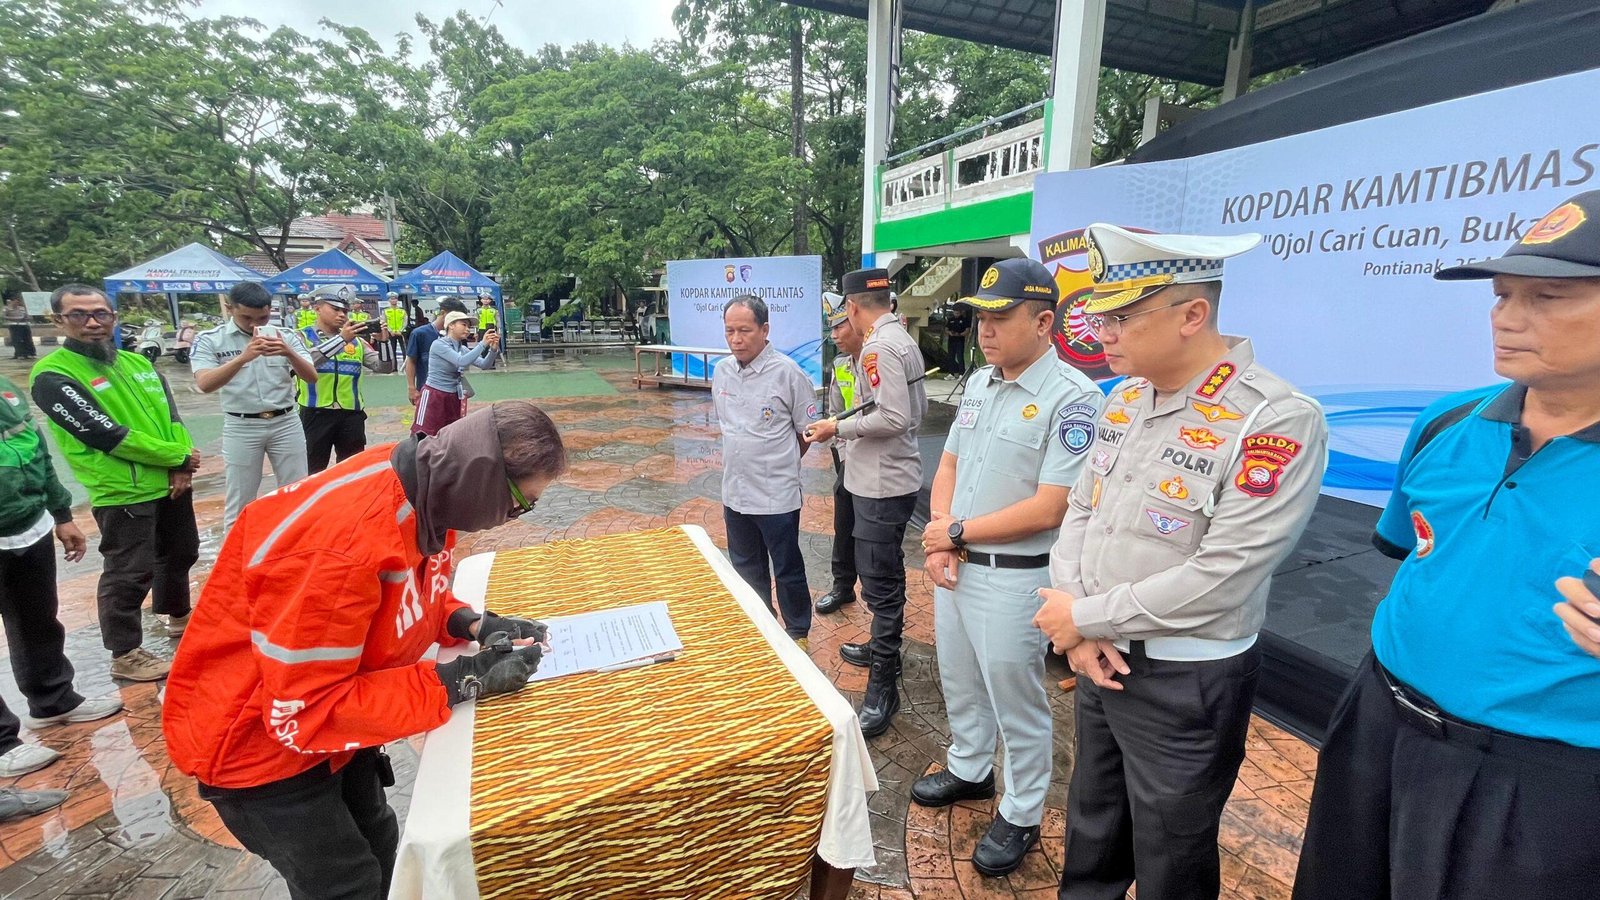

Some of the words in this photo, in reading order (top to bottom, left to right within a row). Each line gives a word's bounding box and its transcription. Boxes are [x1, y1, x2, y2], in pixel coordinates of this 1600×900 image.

[1221, 183, 1334, 225] KOPDAR
[1340, 143, 1600, 211] KAMTIBMAS
[1263, 230, 1313, 261] "Ojol
[1319, 226, 1364, 252] Cari
[1371, 223, 1449, 250] Cuan,
[1460, 212, 1541, 243] Buk
[1045, 237, 1089, 257] KALIMA
[315, 268, 358, 276] YAMAHA
[1363, 259, 1444, 276] Pontianak
[680, 287, 709, 299] KOPDAR
[759, 286, 804, 299] DITLANTAS
[708, 302, 719, 312] Cari
[216, 349, 242, 358] RASYID
[61, 385, 114, 429] tokopedia
[963, 398, 983, 408] AGUS
[52, 402, 91, 433] gopay
[1099, 426, 1124, 446] VALENT
[1246, 436, 1297, 454] POLDA
[1160, 447, 1215, 477] POLRI
